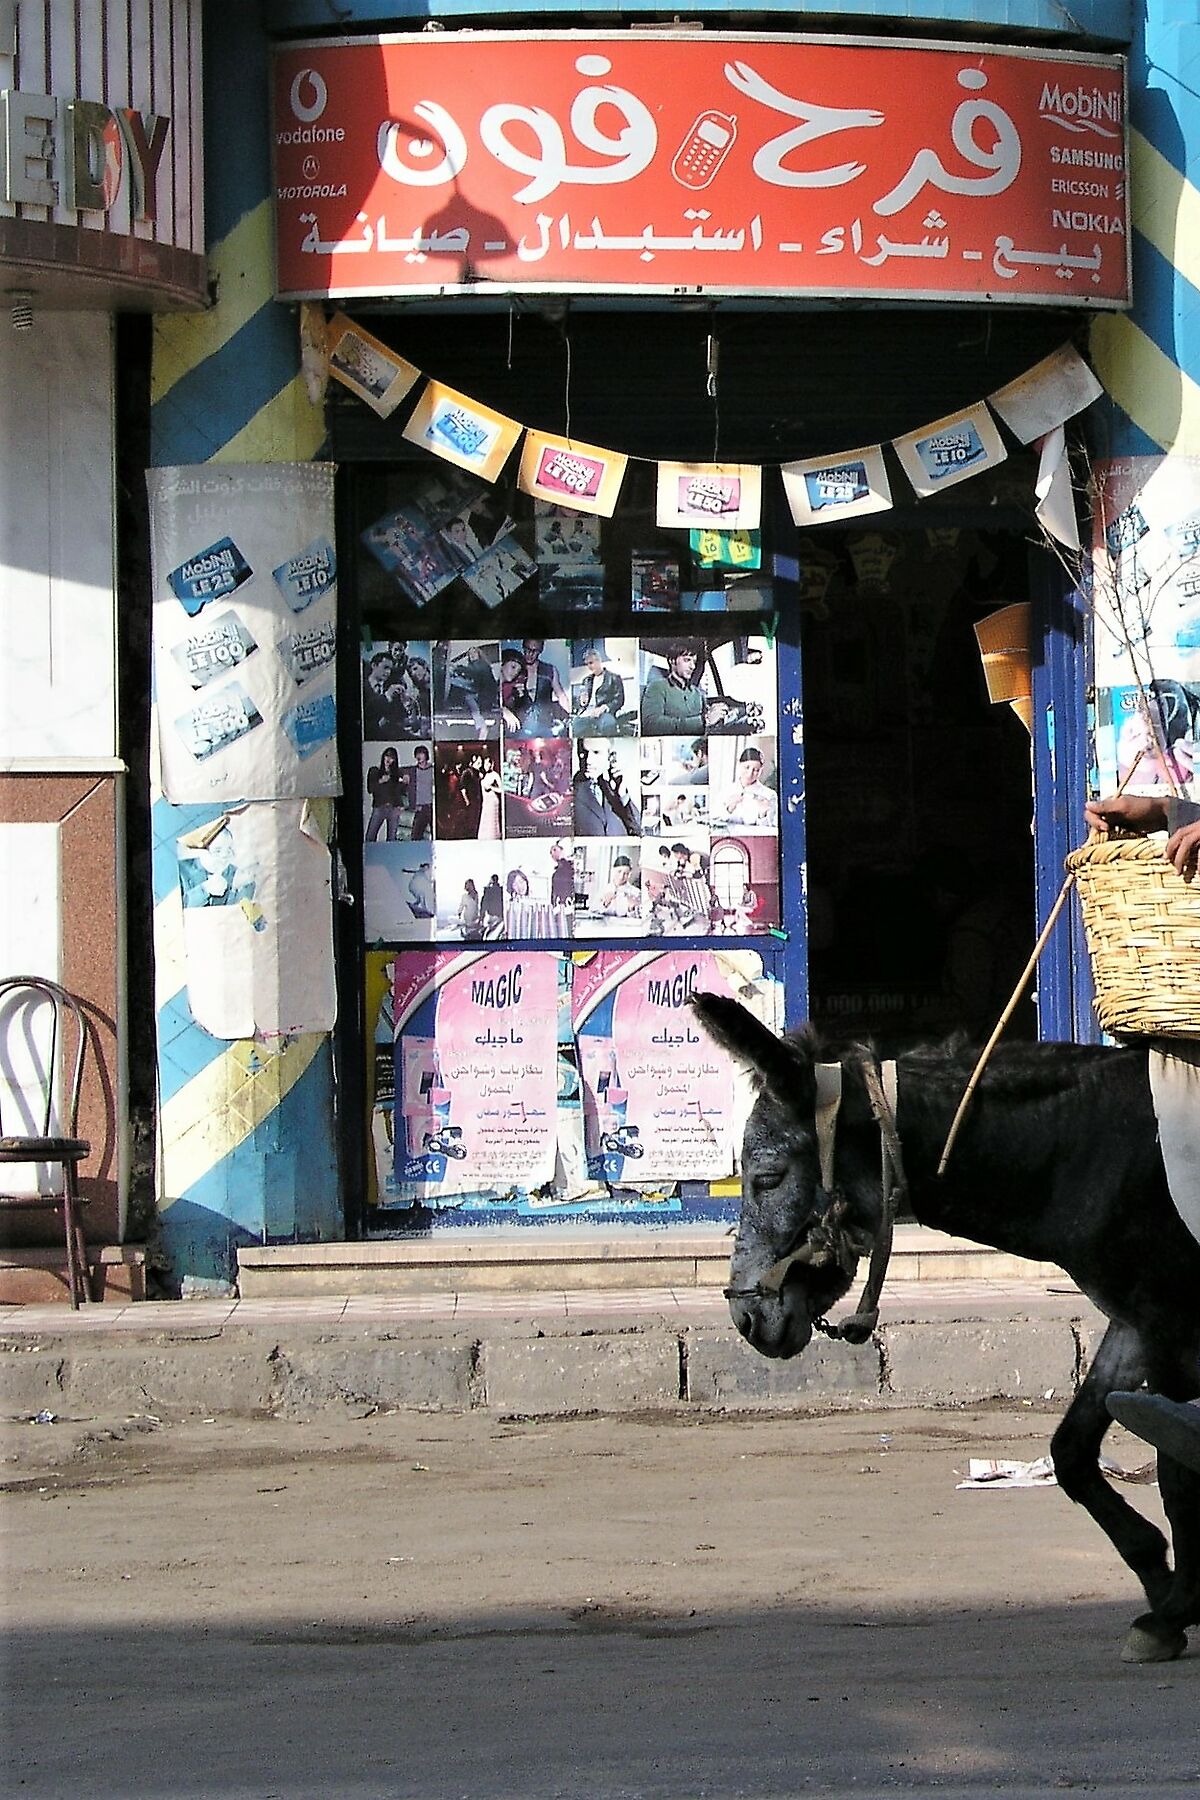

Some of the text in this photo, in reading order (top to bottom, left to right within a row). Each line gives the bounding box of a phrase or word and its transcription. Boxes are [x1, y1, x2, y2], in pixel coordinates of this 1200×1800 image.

[276, 124, 346, 144] vodafone
[378, 54, 1023, 217] فرح فون
[1050, 145, 1124, 172] SAMSUNG
[277, 183, 348, 199] MOTOROLA
[1051, 178, 1109, 199] ERICSSON
[1052, 208, 1125, 235] NOKIA
[301, 207, 1102, 282] بيع شراء استبدال صيانة
[471, 963, 523, 1010] MAGIC
[647, 964, 698, 1010] MAGIC
[475, 1028, 524, 1048] ماجيك
[651, 1027, 700, 1048] ماجيك
[425, 1159, 441, 1175] CE
[604, 1158, 618, 1173] CE
